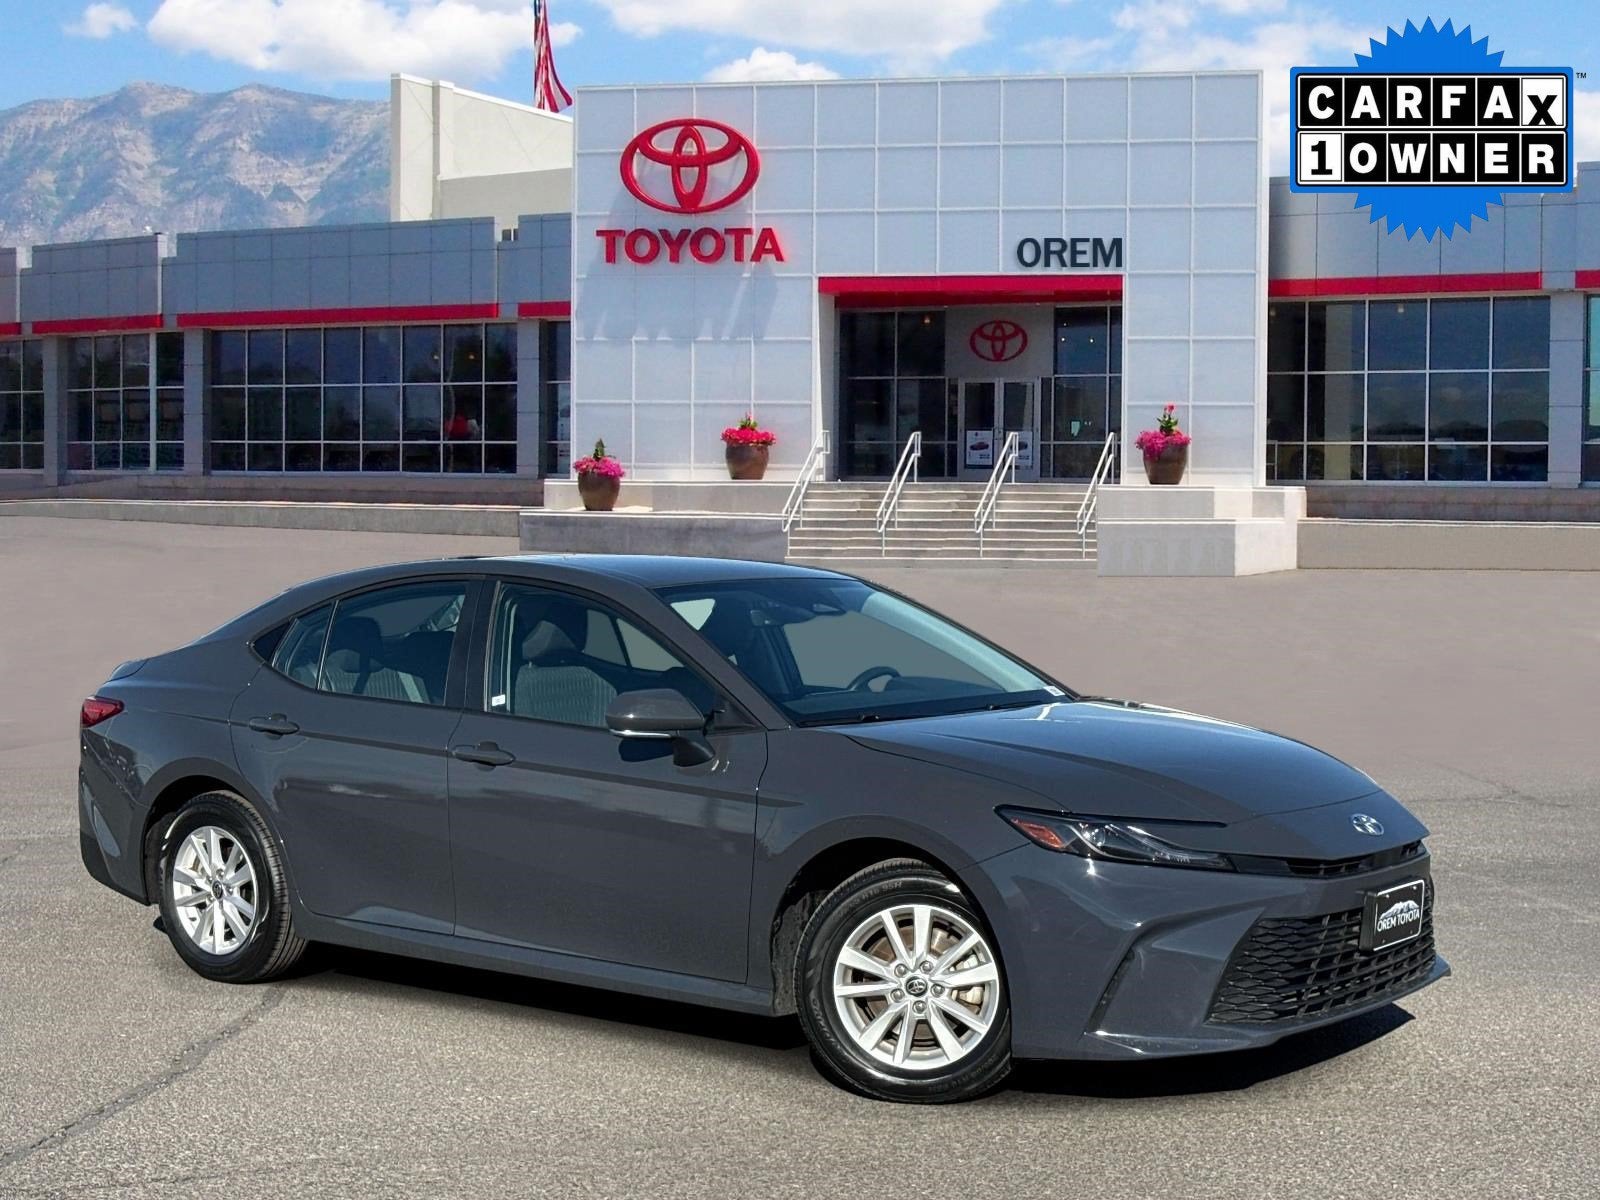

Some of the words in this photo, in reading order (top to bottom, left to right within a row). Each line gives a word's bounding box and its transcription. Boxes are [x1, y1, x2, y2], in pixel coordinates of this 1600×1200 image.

[595, 227, 785, 264] TOYOTA
[1016, 237, 1123, 268] OREM
[1377, 916, 1397, 932] OREM
[1397, 909, 1420, 925] TOYOTA
